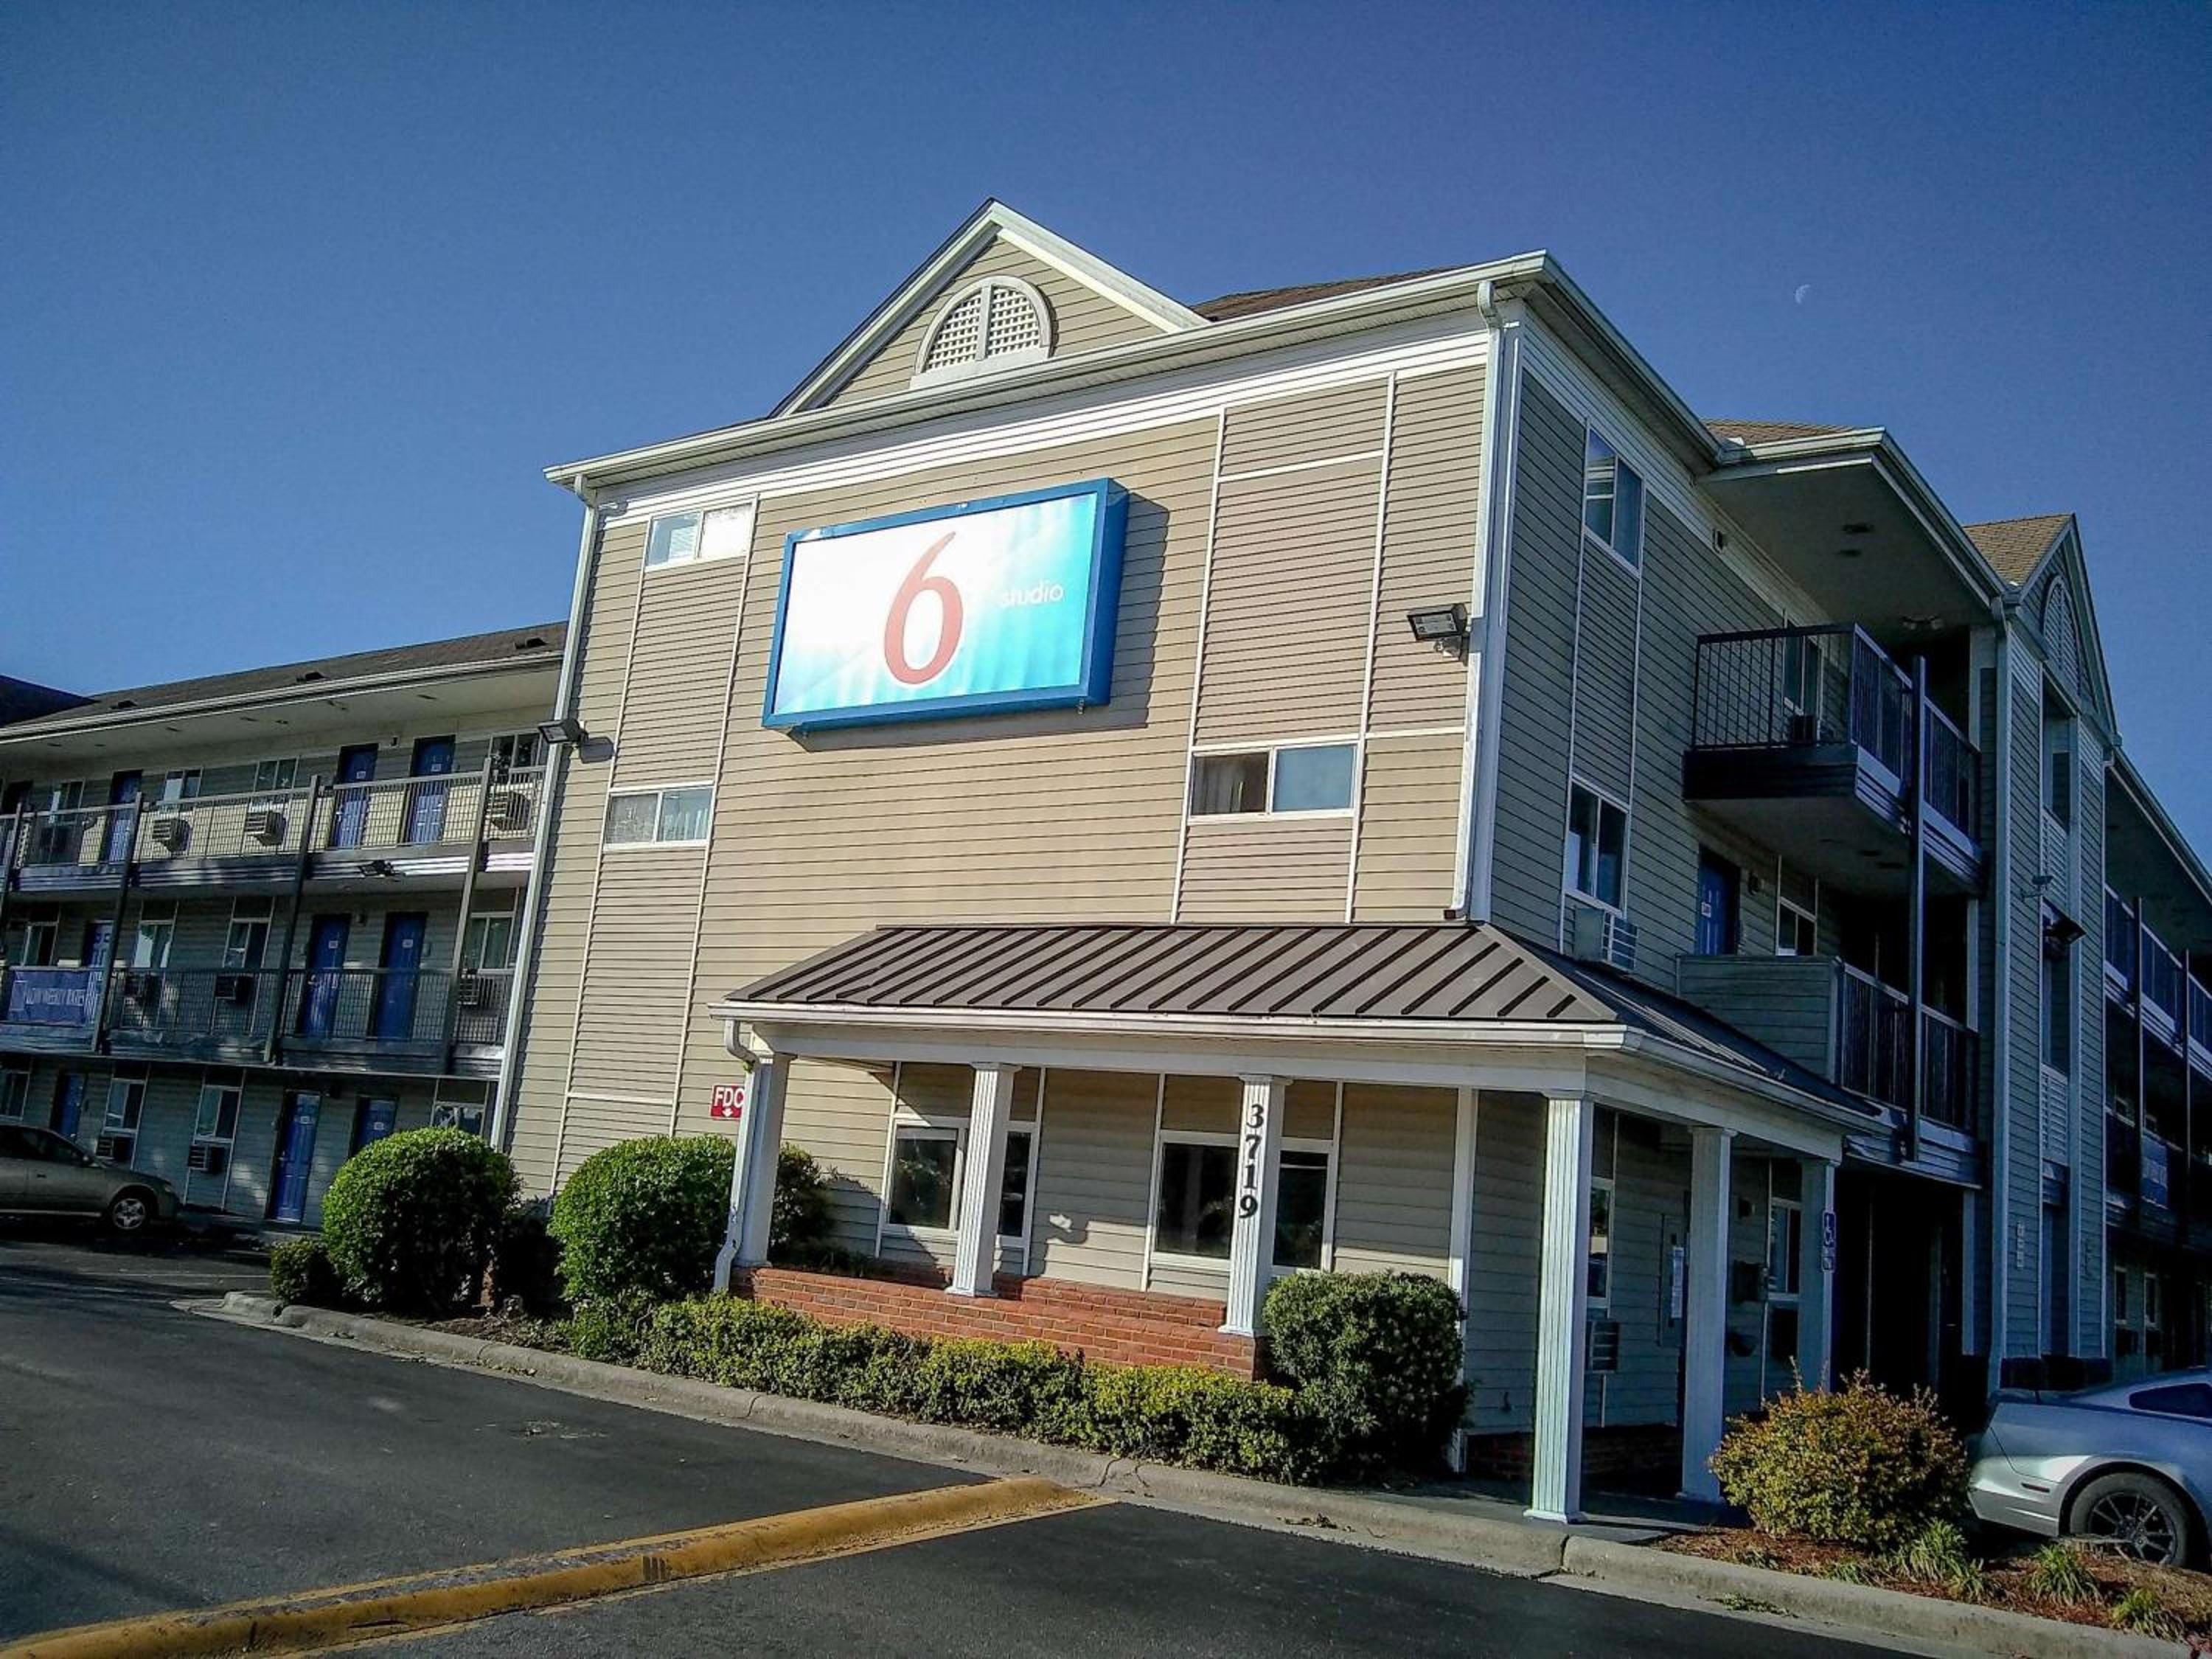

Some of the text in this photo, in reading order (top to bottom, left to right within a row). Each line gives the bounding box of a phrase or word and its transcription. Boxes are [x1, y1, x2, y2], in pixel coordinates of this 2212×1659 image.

[884, 531, 1064, 685] 6 studio
[1239, 1104, 1265, 1219] 3719
